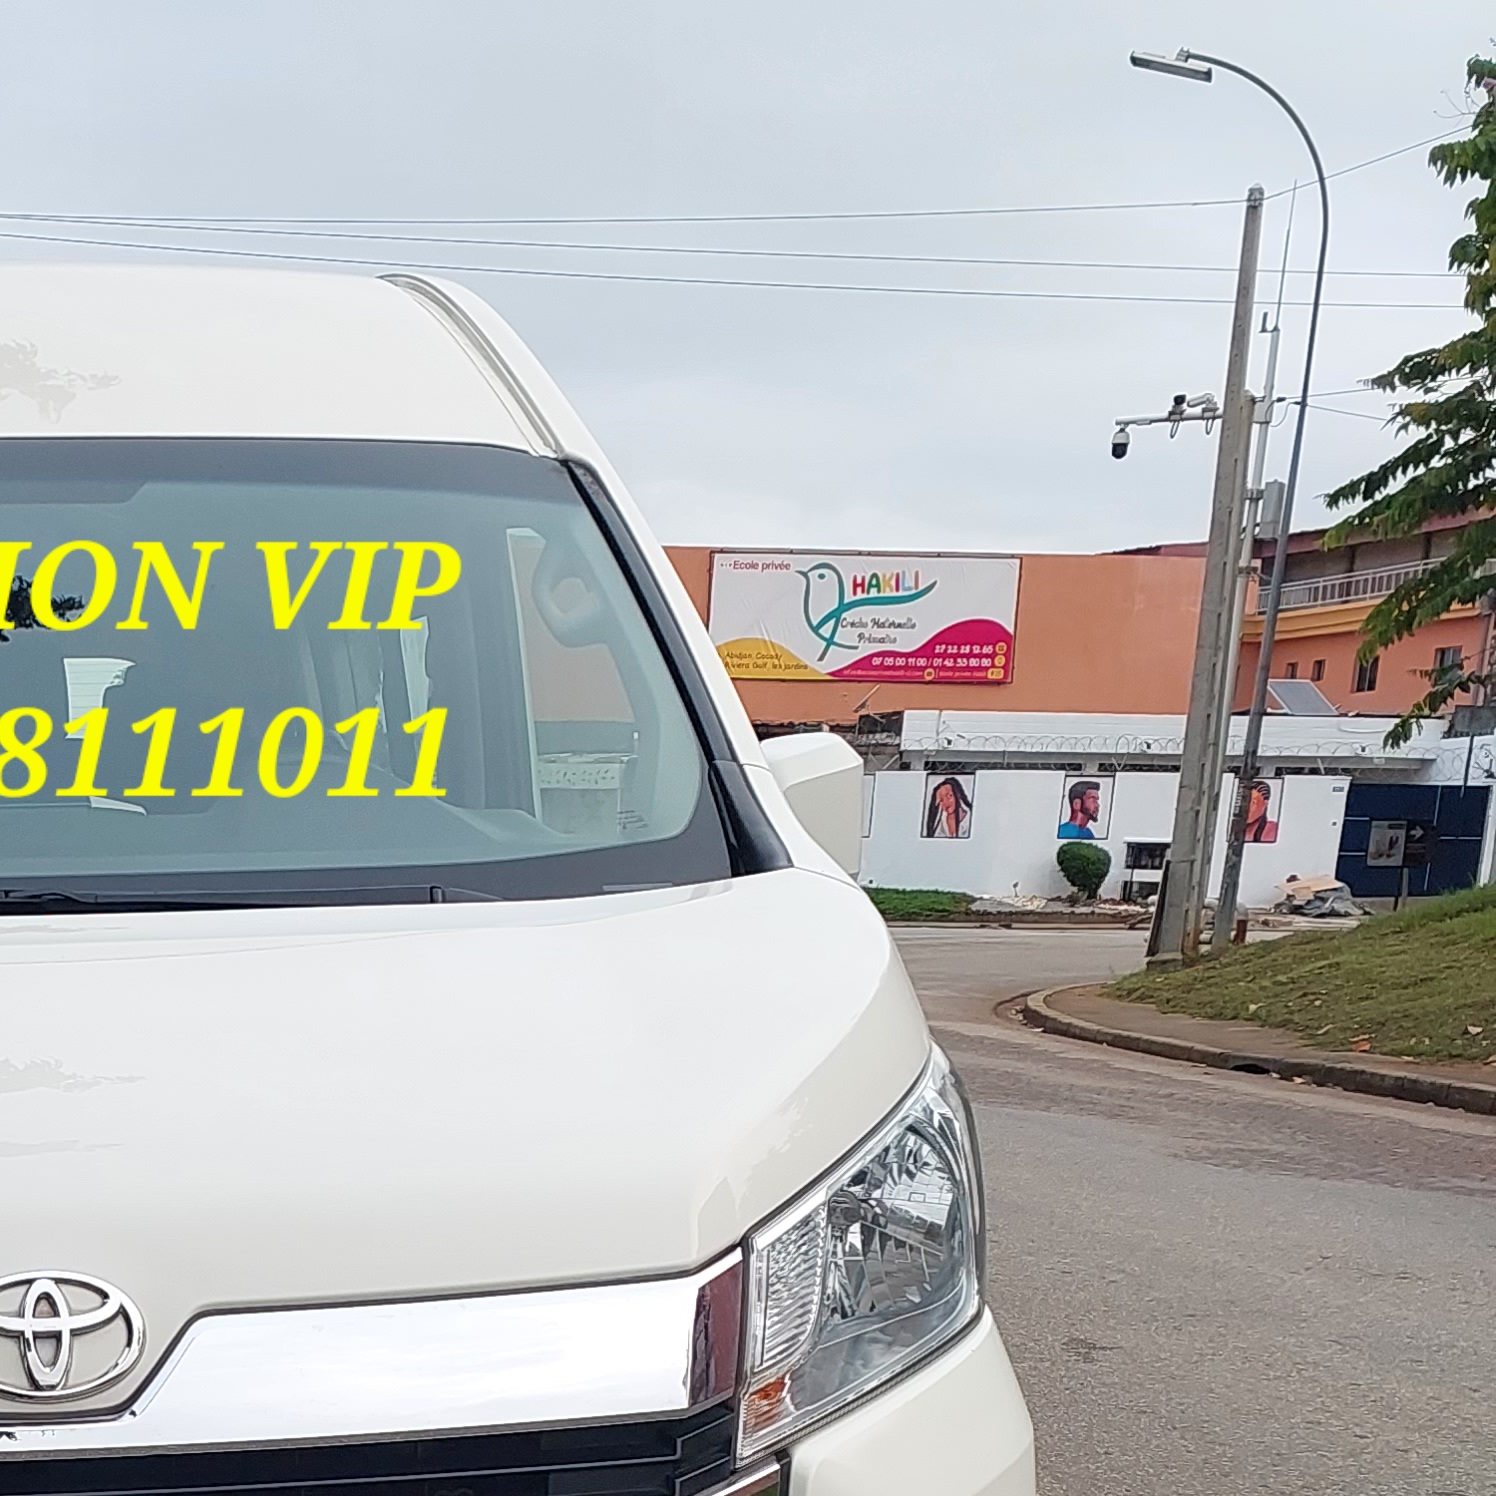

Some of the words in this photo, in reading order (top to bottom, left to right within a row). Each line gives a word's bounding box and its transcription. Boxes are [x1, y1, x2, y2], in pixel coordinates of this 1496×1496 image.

[732, 560, 760, 570] Ecole
[761, 560, 791, 573] privée
[852, 570, 920, 596] HAKILI
[871, 656, 883, 666] 07
